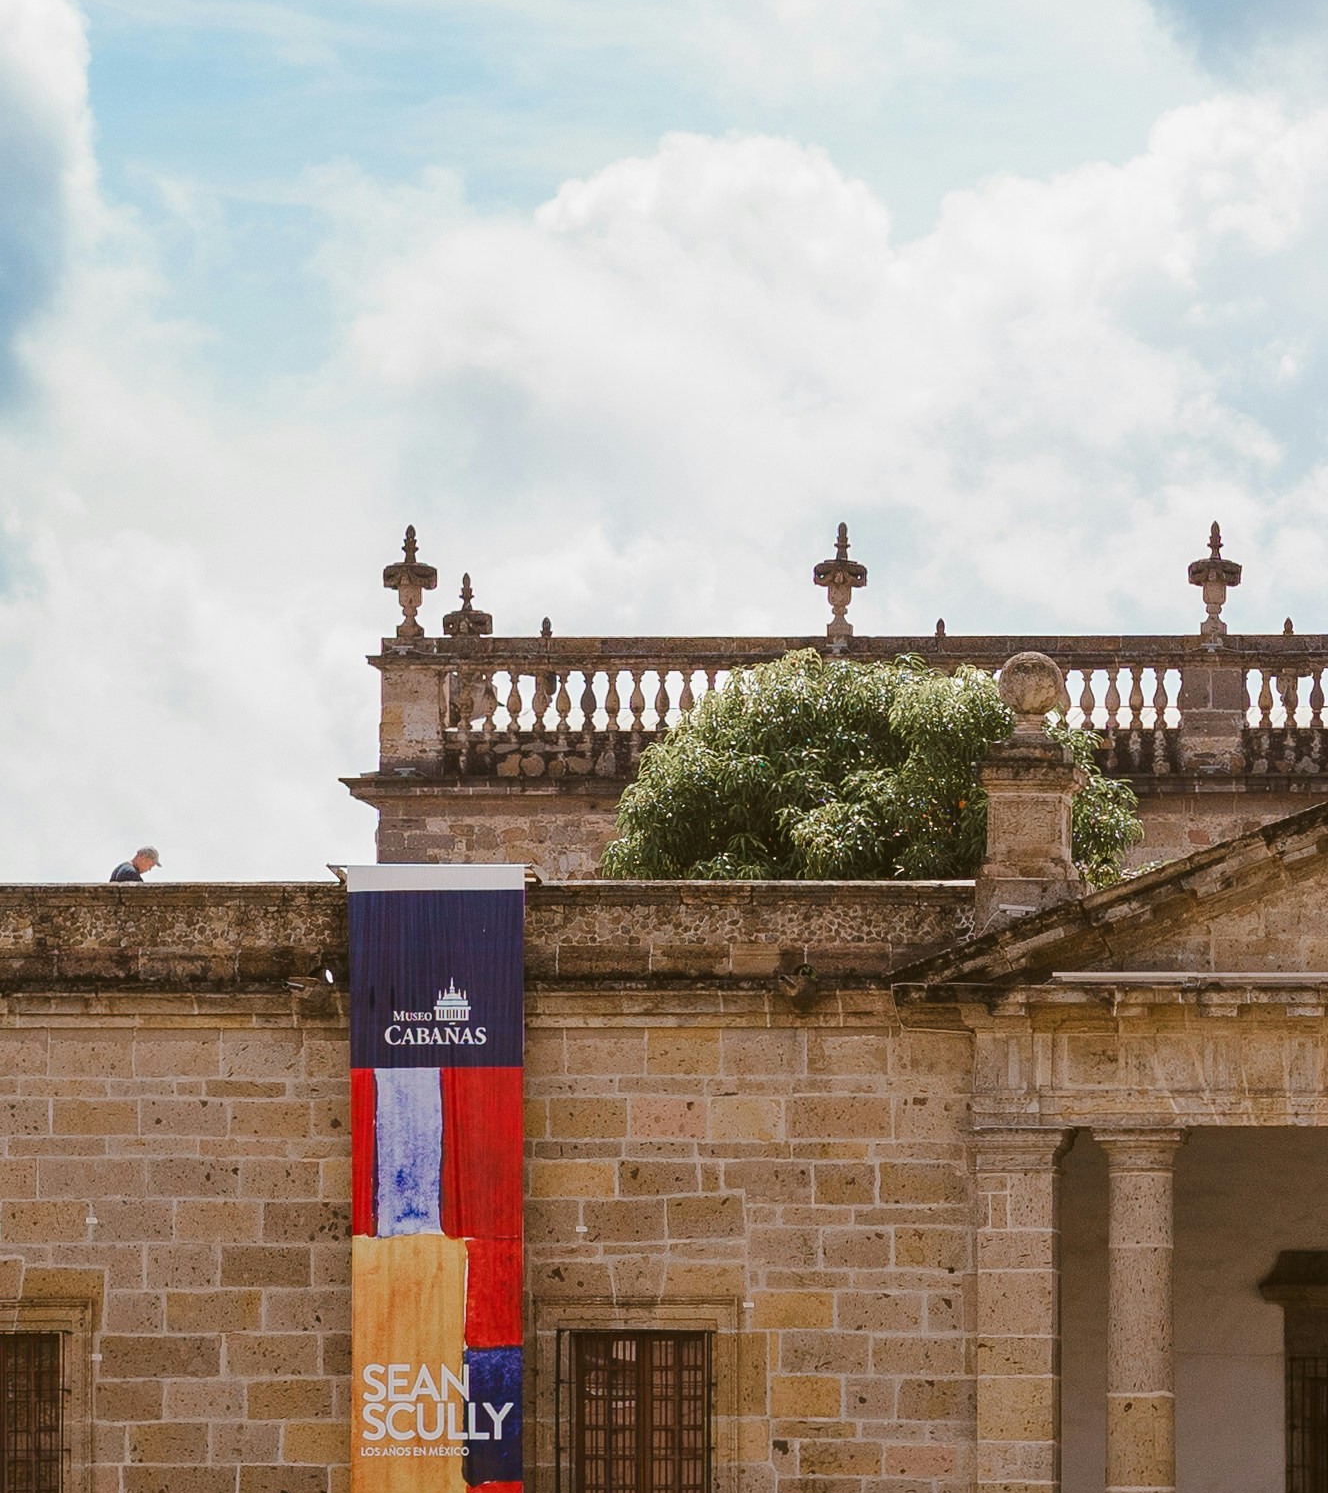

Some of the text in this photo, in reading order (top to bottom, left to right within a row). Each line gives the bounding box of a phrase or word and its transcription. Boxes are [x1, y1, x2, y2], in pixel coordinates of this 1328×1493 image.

[384, 1022, 487, 1046] CABAÑAS
[362, 1363, 470, 1402] SEAN
[362, 1402, 514, 1441] SCULLY
[360, 1443, 470, 1457] LOS AÑOS EN MÉXICO
